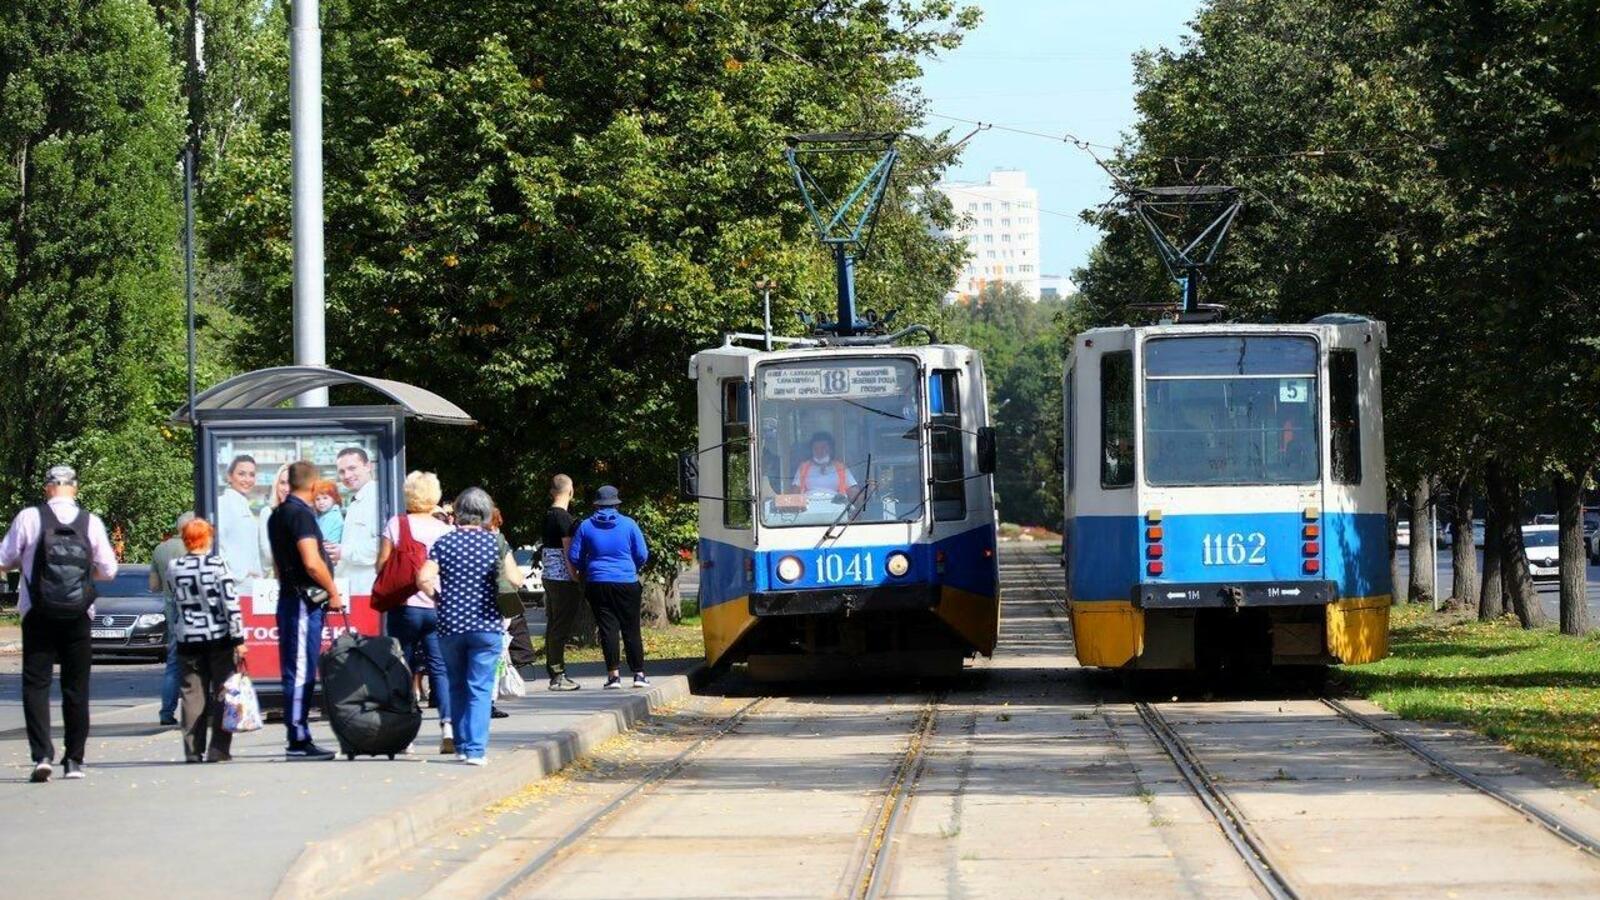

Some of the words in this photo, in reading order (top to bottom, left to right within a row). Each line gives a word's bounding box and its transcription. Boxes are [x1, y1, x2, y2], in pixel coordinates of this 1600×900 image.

[823, 370, 846, 392] 18
[1287, 381, 1298, 399] 5
[1203, 531, 1266, 564] 1162
[816, 552, 873, 583] 1041
